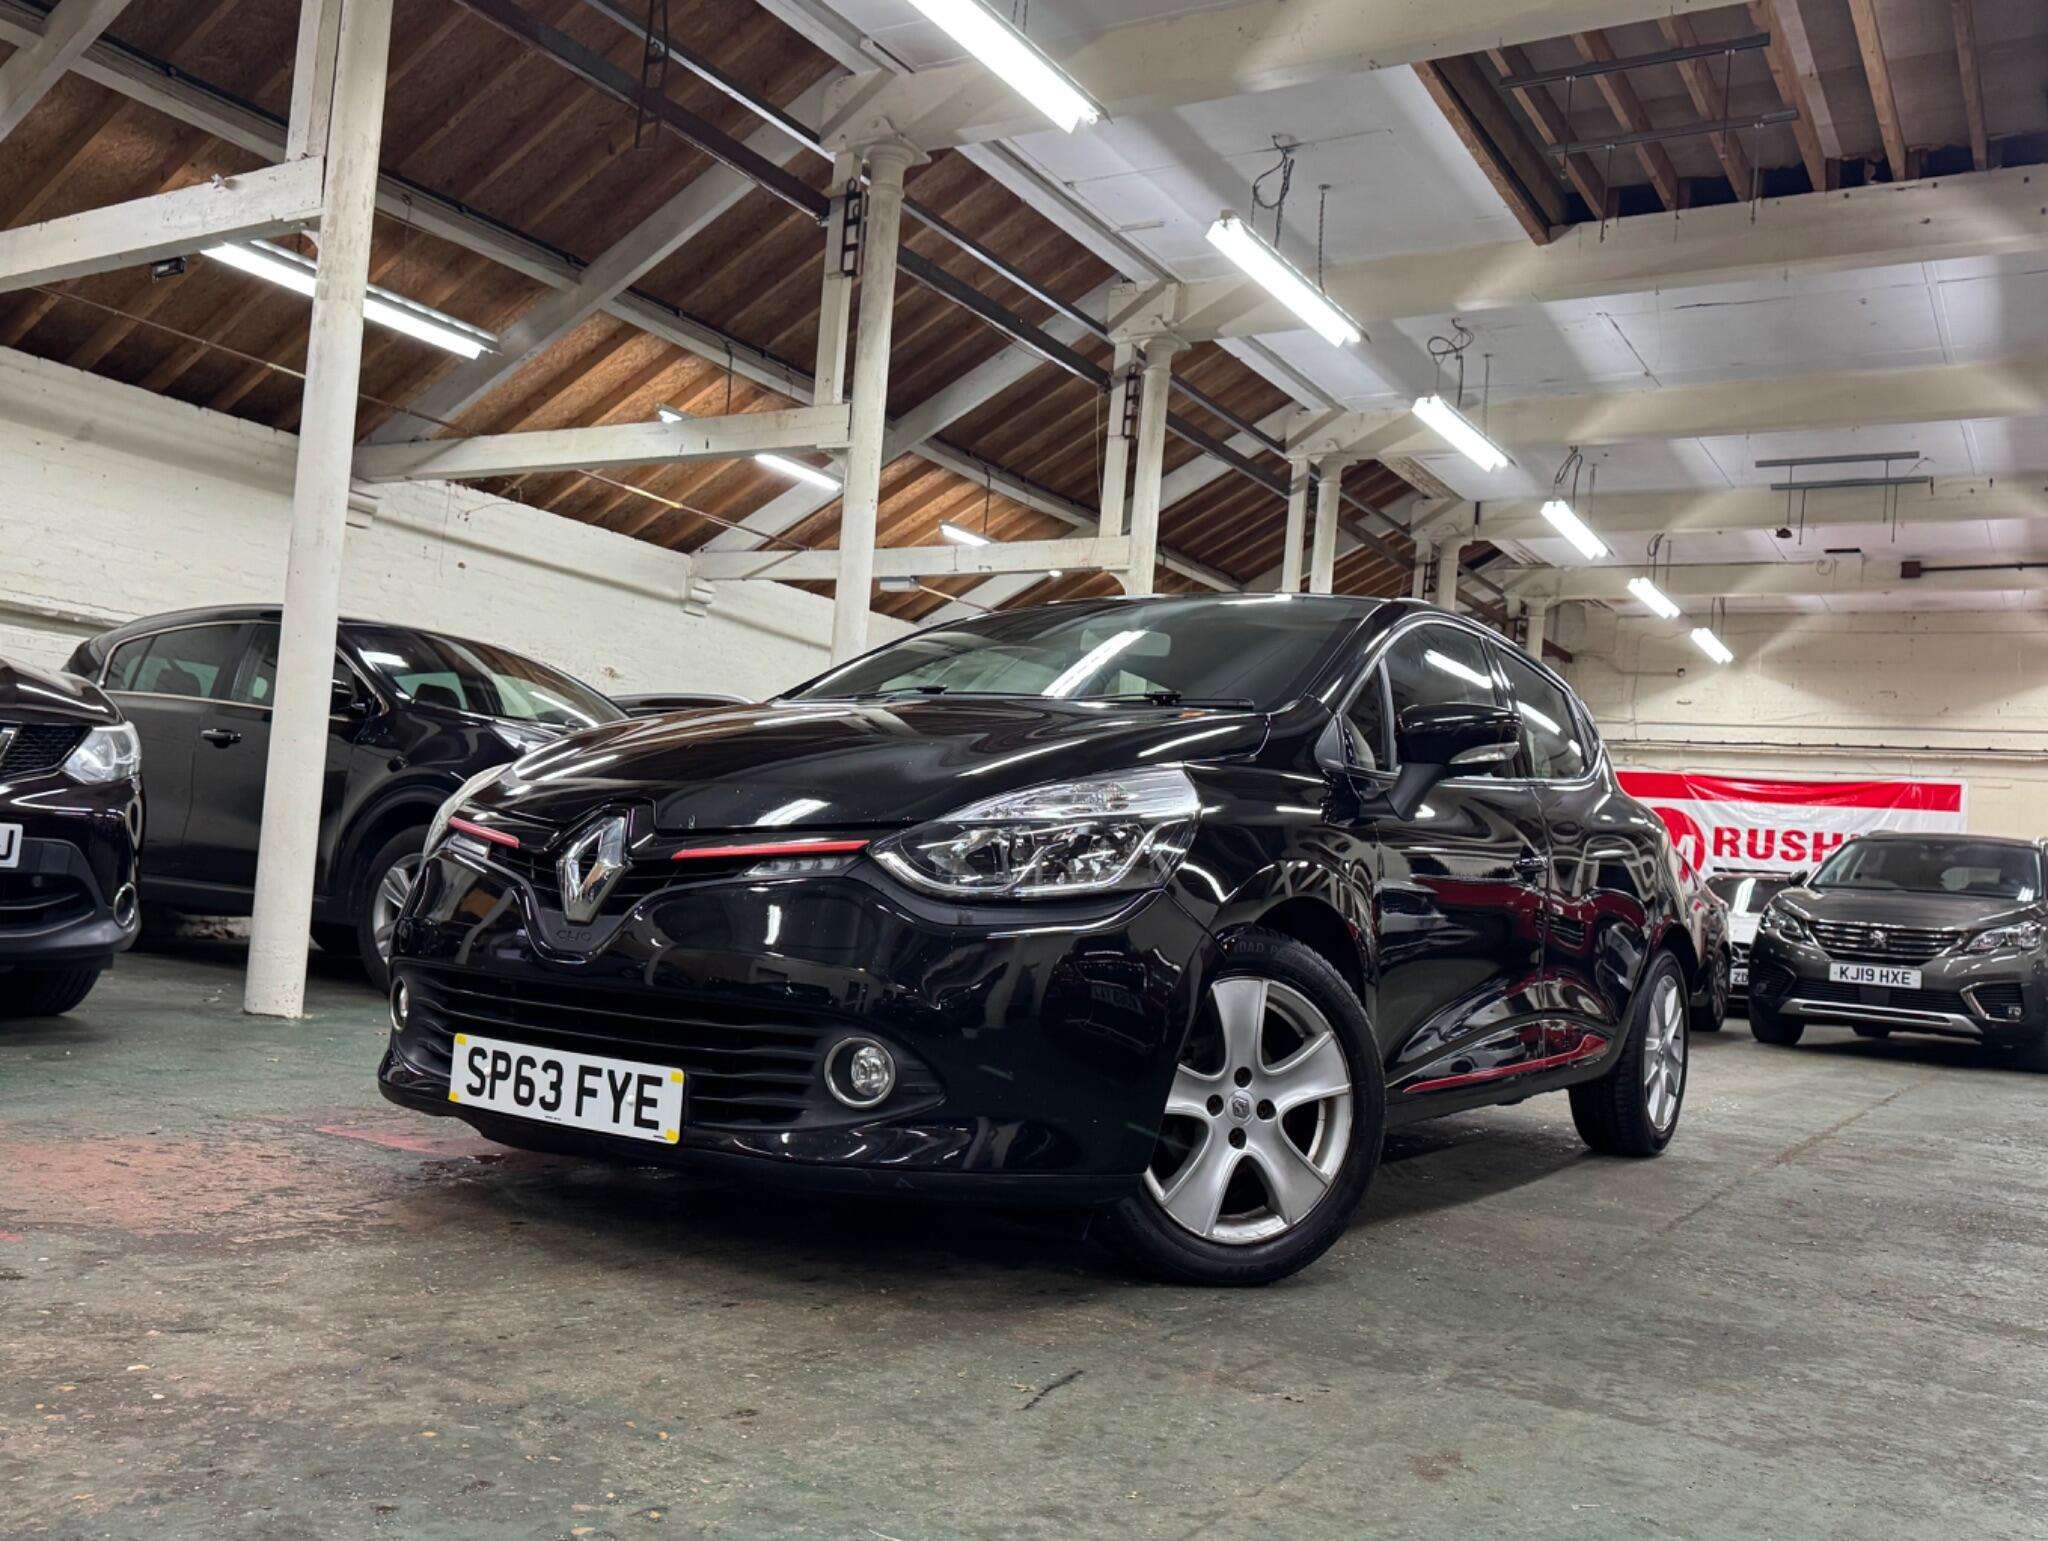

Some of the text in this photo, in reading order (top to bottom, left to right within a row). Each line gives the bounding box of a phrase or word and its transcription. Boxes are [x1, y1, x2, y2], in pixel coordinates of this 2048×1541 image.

[1712, 826, 1861, 863] RUSH
[1839, 966, 1912, 985] KJ19 HXE
[466, 1046, 663, 1131] SP63 FYE
